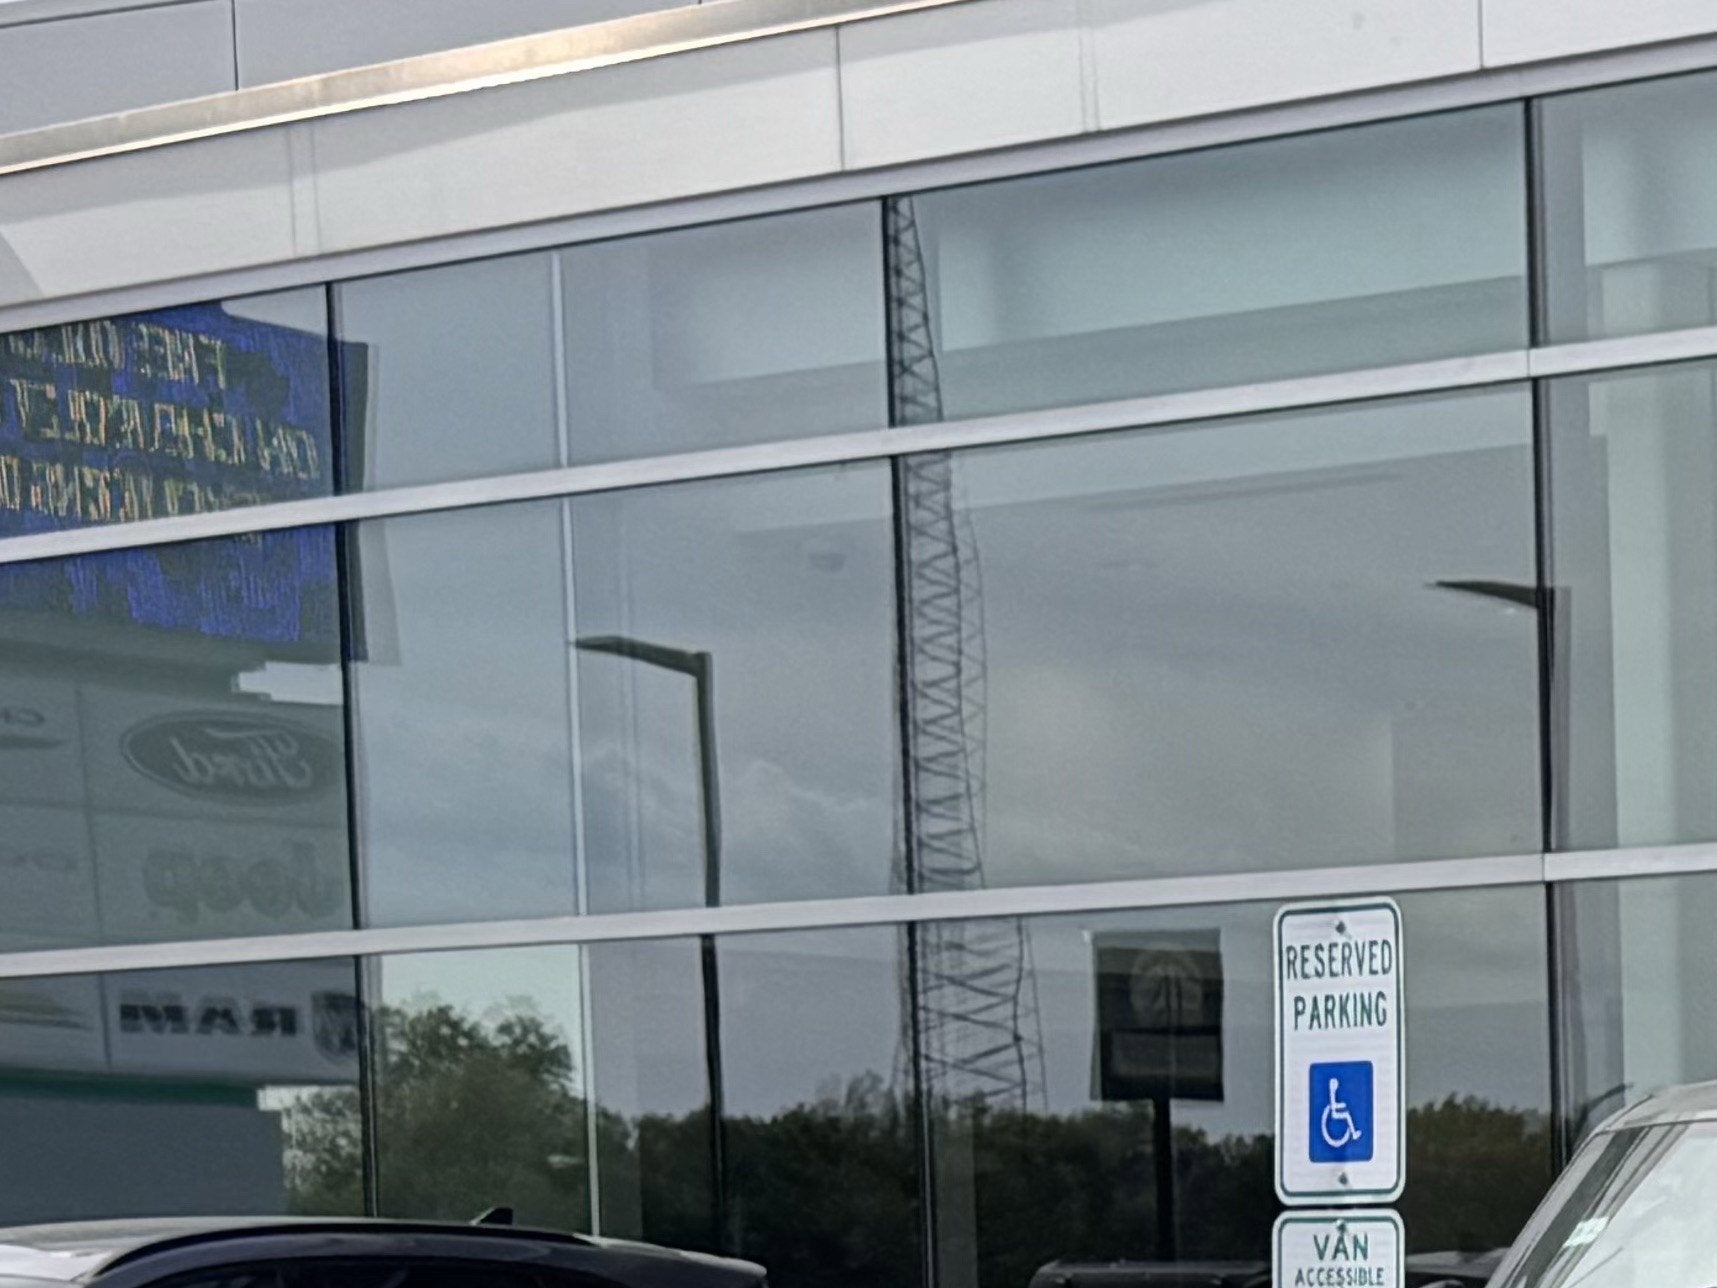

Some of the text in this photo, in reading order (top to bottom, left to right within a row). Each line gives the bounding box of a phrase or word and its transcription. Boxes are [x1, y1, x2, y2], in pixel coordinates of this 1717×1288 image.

[1286, 939, 1393, 980] RESERVED
[1294, 992, 1388, 1030] PARKING
[1313, 1234, 1369, 1262] VAN
[1295, 1266, 1385, 1287] ACCESSIBLE
